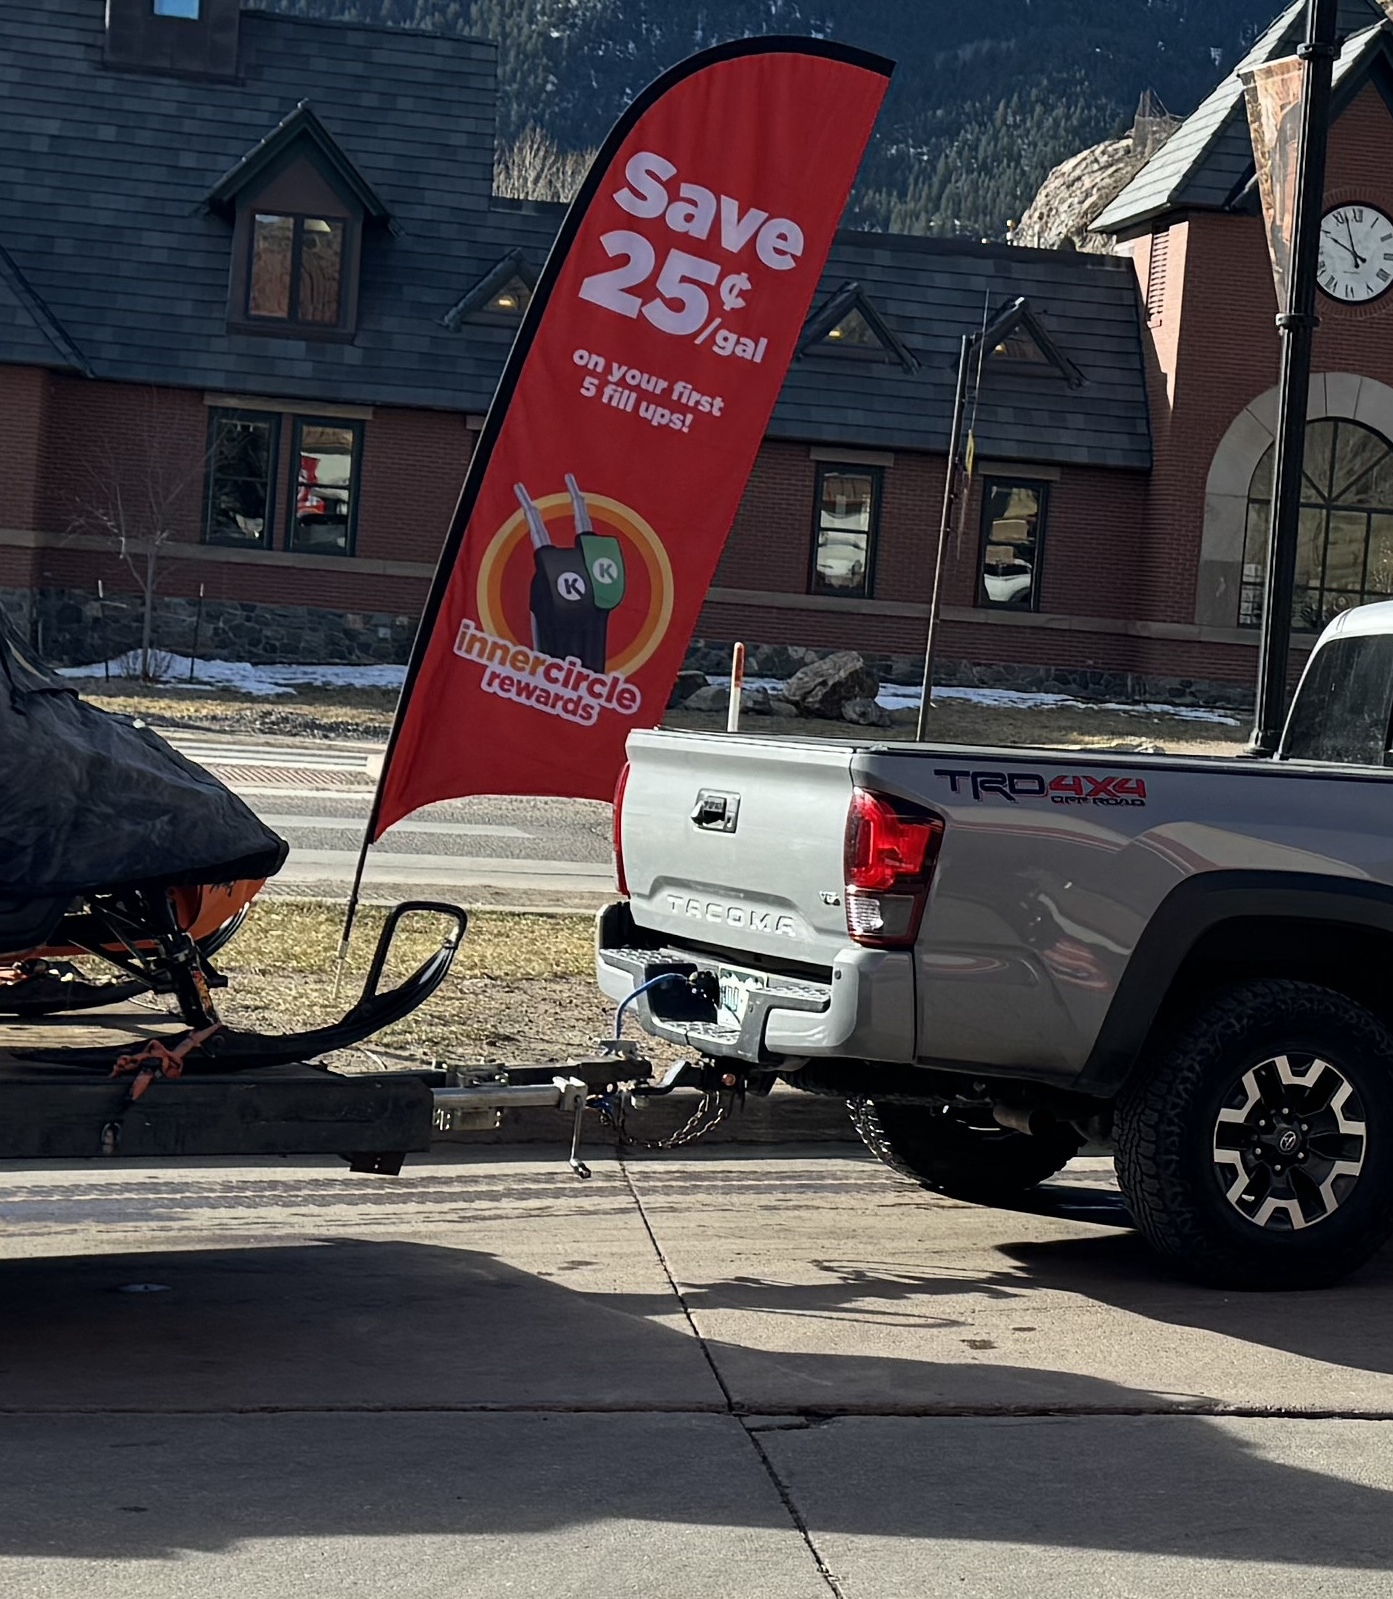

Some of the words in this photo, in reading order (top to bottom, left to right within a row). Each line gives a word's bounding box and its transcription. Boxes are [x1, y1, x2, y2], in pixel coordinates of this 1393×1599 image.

[613, 151, 804, 271] Save
[572, 349, 605, 373] on
[607, 362, 669, 395] your
[671, 381, 725, 417] first
[580, 376, 599, 397] 5
[602, 383, 637, 412] fill
[638, 401, 694, 433] ups!
[563, 577, 585, 599] K
[598, 562, 617, 583] K
[455, 620, 639, 712] innercircle
[485, 669, 596, 722] rewards
[934, 769, 1047, 803] TRD
[1092, 797, 1146, 807] ROAD
[666, 894, 797, 938] TACOMA
